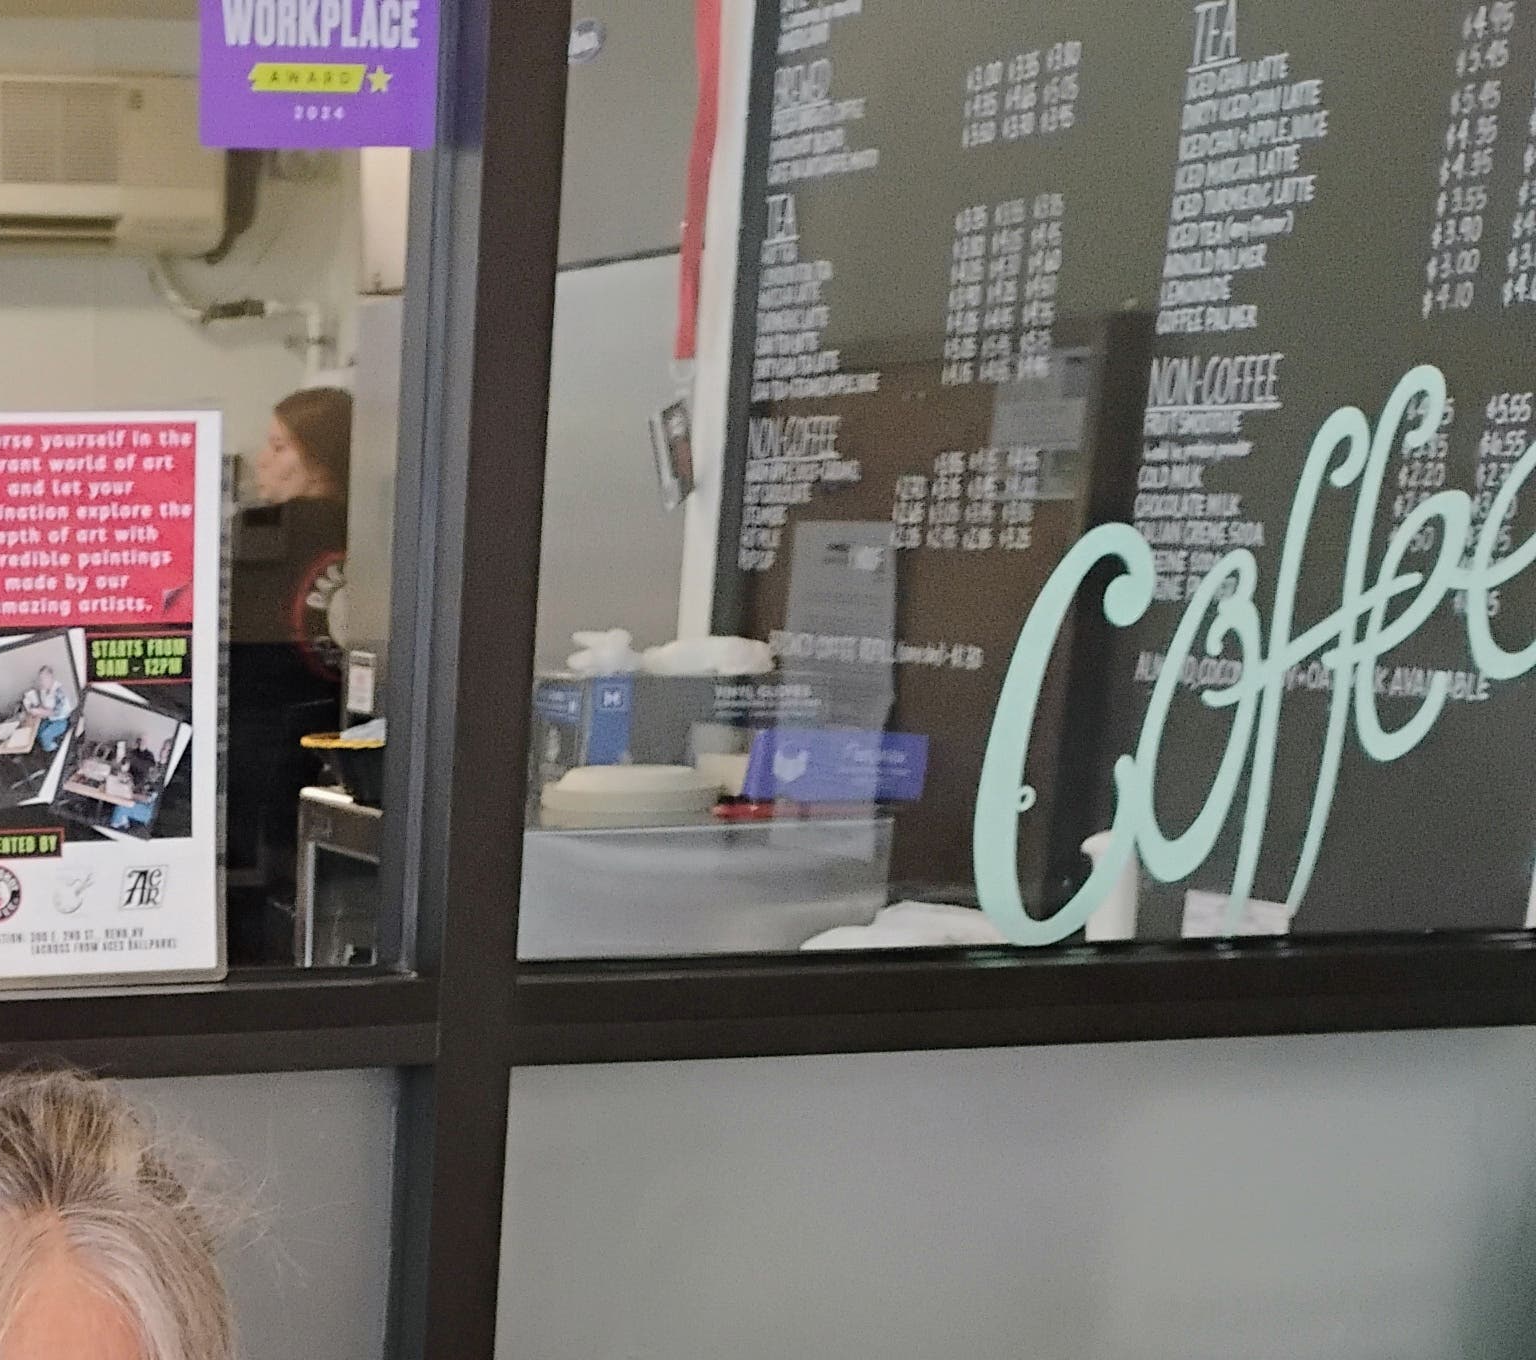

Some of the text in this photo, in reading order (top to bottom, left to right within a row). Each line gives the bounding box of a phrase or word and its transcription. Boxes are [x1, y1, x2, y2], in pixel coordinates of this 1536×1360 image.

[221, 0, 421, 48] WORKPLACE
[1192, 0, 1238, 68] TEA
[268, 70, 351, 84] AWARD
[1147, 351, 1285, 406] NON-COFFEE
[40, 429, 127, 453] yourself
[159, 429, 193, 449] the
[49, 454, 108, 474] world
[114, 452, 138, 472] of
[142, 455, 175, 472] art
[7, 479, 135, 501] and let your
[75, 501, 154, 524] explore
[159, 501, 194, 519] the
[47, 525, 71, 546] of
[75, 527, 108, 545] art
[114, 525, 160, 545] with
[77, 549, 174, 571] paintings
[4, 573, 131, 595] made by our
[78, 596, 154, 615] artists.
[91, 637, 188, 660] STARTS FROM
[144, 656, 184, 677] 12PM
[38, 834, 59, 854] BY
